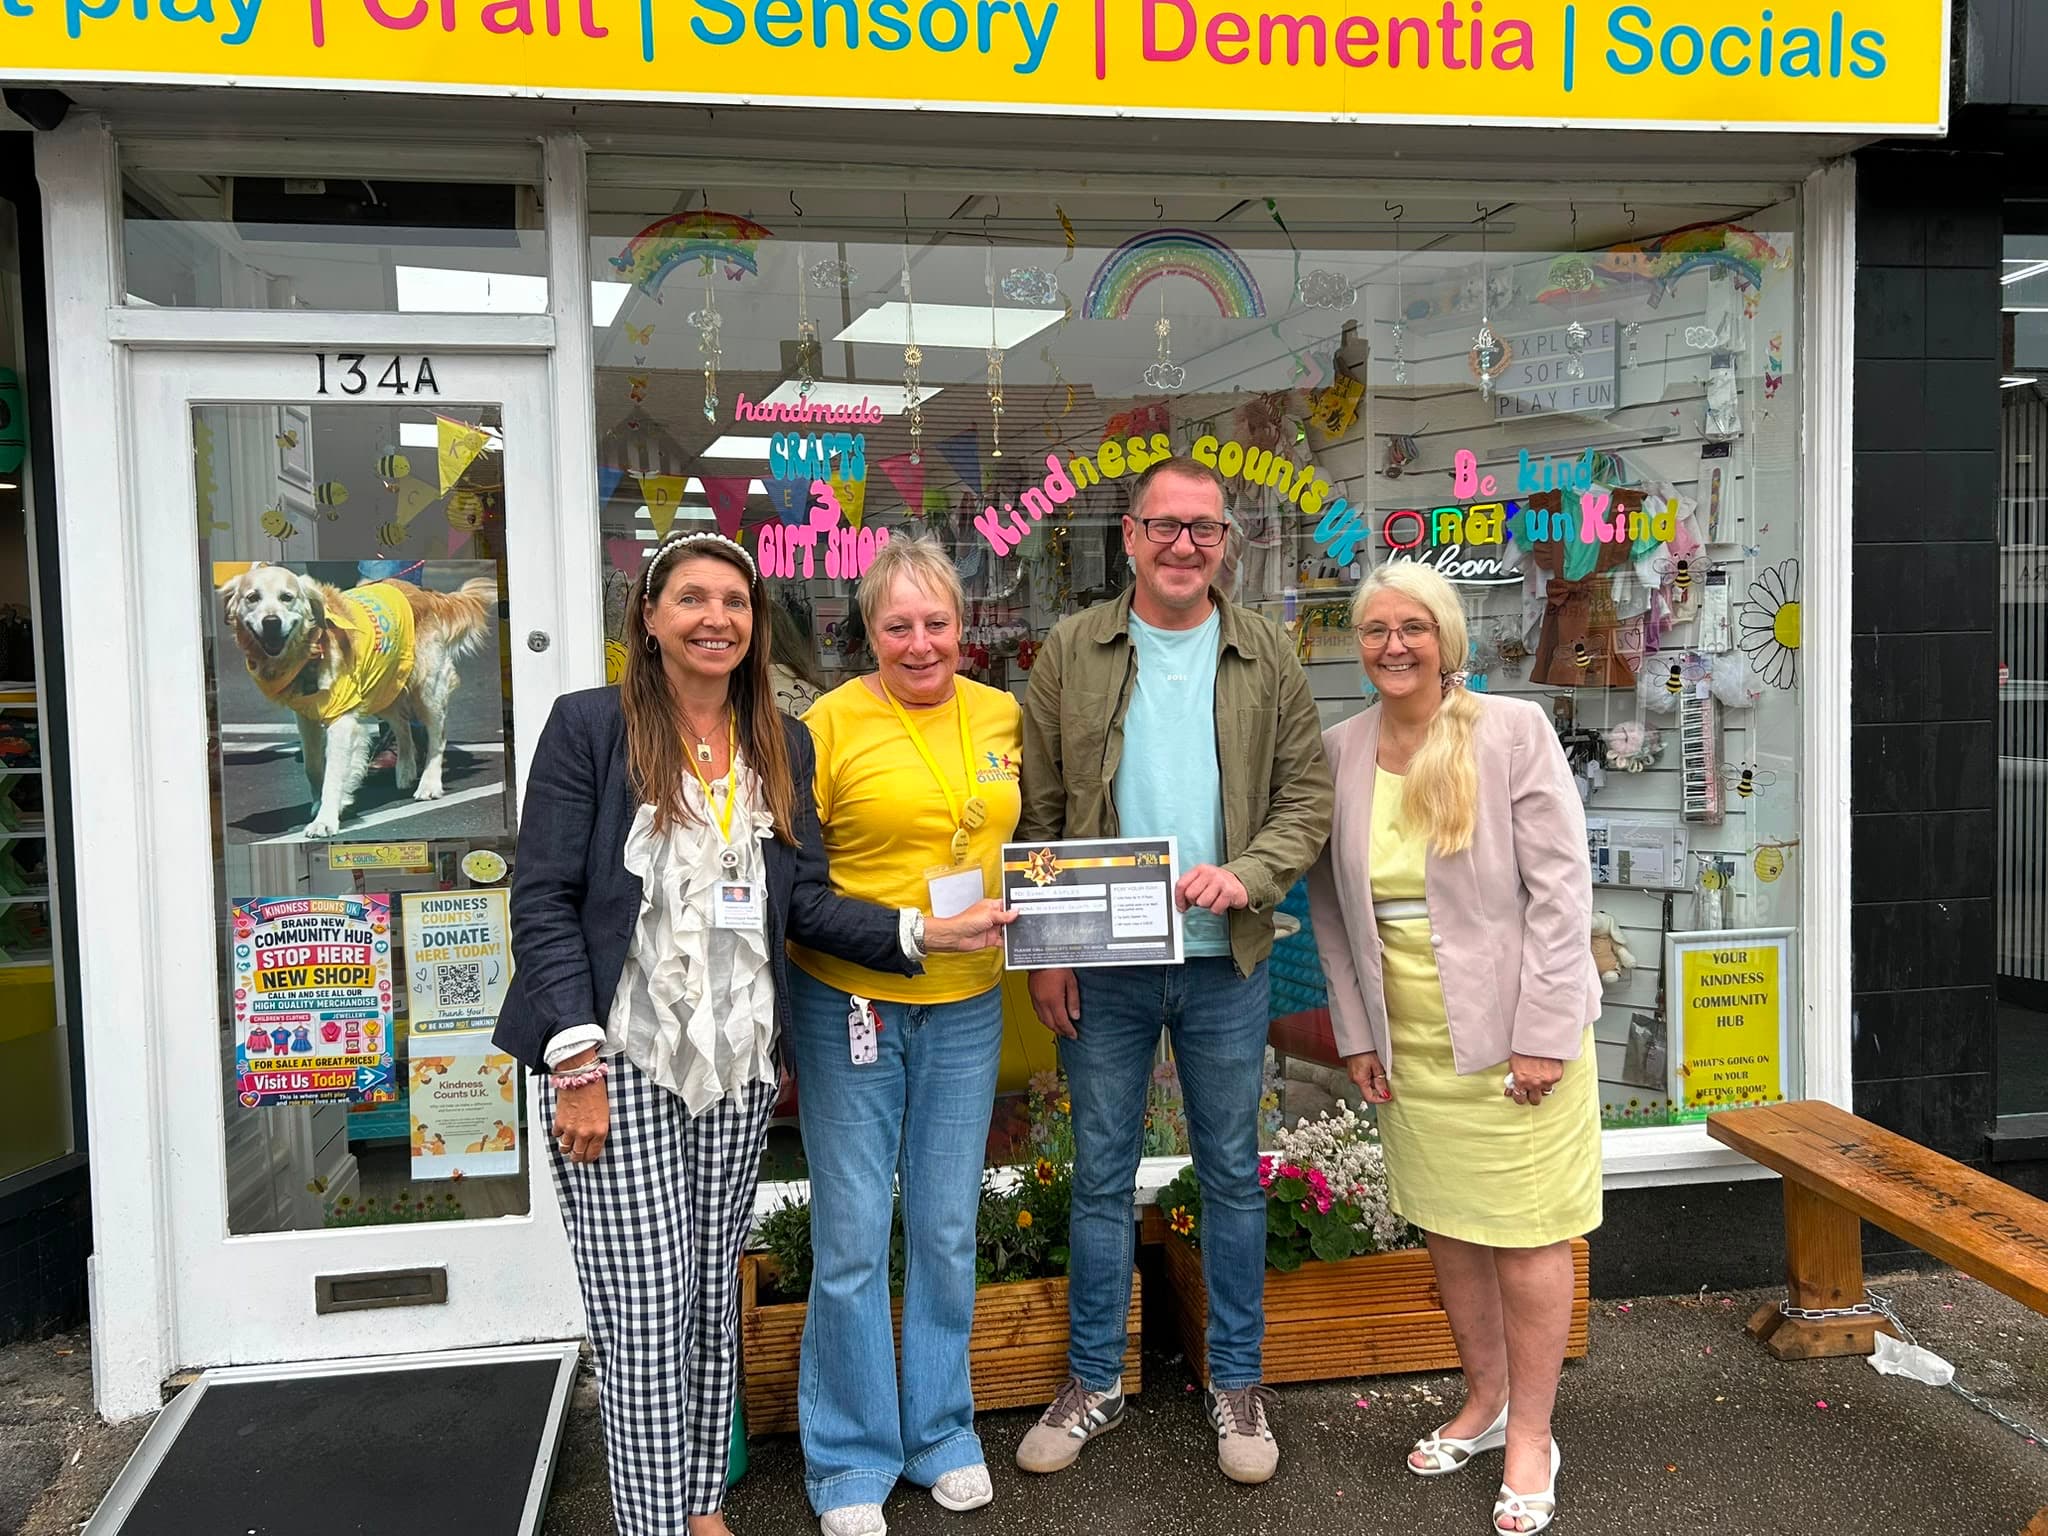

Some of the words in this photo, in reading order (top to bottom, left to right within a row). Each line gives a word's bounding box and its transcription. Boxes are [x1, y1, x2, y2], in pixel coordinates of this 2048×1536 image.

[66, 0, 262, 45] py
[690, 0, 1059, 74] Sensory
[1142, 0, 1534, 71] Dementia
[1606, 6, 1888, 79] Socials
[1512, 325, 1609, 357] XPLORE
[316, 353, 440, 395] 134A
[735, 392, 883, 424] handmade
[1500, 391, 1558, 415] PLAY
[1573, 384, 1611, 405] FUN
[769, 432, 866, 481] CRAFTS
[1454, 449, 1497, 499] Be
[1517, 447, 1594, 493] kind
[974, 433, 1173, 557] Kindness
[1191, 435, 1329, 514] counts
[1313, 498, 1372, 567] UK
[1440, 503, 1505, 545] not
[757, 523, 818, 579] GIFT
[265, 901, 309, 917] KINDNESS
[311, 900, 344, 912] COUNTS
[346, 903, 358, 915] UK
[421, 898, 488, 913] KINDNESS
[281, 918, 318, 929] BRAND
[321, 918, 345, 928] NEW
[421, 912, 472, 925] COUNTS
[255, 928, 340, 948] COMMUNITY
[344, 929, 373, 945] HUB
[422, 928, 490, 948] DONATE
[262, 948, 311, 970] STOP
[316, 946, 365, 964] HERE
[415, 949, 450, 963] HERE
[454, 943, 501, 960] TODAY!
[1712, 951, 1748, 965] YOUR
[262, 968, 308, 989] NEW
[313, 967, 370, 985] SHOP!
[1700, 972, 1764, 987] KINDNESS
[268, 991, 286, 1000] CALL
[288, 990, 297, 999] IN
[298, 990, 314, 998] AND
[316, 989, 330, 998] SEE
[331, 989, 344, 997] ALL
[346, 988, 363, 996] OUR
[1692, 993, 1769, 1009] COMMUNITY
[254, 1001, 276, 1010] HIGH
[278, 999, 315, 1010] QUALITY
[316, 998, 376, 1008] MERCHANDISE
[1716, 1014, 1745, 1028] HUB
[254, 1060, 273, 1070] FOR
[275, 1058, 299, 1068] SALE
[301, 1057, 314, 1067] AT
[315, 1056, 342, 1066] GREAT
[344, 1054, 375, 1065] PRICES!
[1692, 1056, 1725, 1068] WHAT'S
[1727, 1055, 1755, 1065] GOING
[1757, 1055, 1770, 1064] ON
[253, 1074, 287, 1090] Visit
[291, 1073, 309, 1088] Us
[311, 1071, 356, 1089] Today!
[439, 1080, 484, 1090] Kindness
[1713, 1072, 1723, 1082] IN
[1724, 1070, 1749, 1081] YOUR
[433, 1090, 469, 1099] Counts
[1696, 1086, 1734, 1097] MEETING
